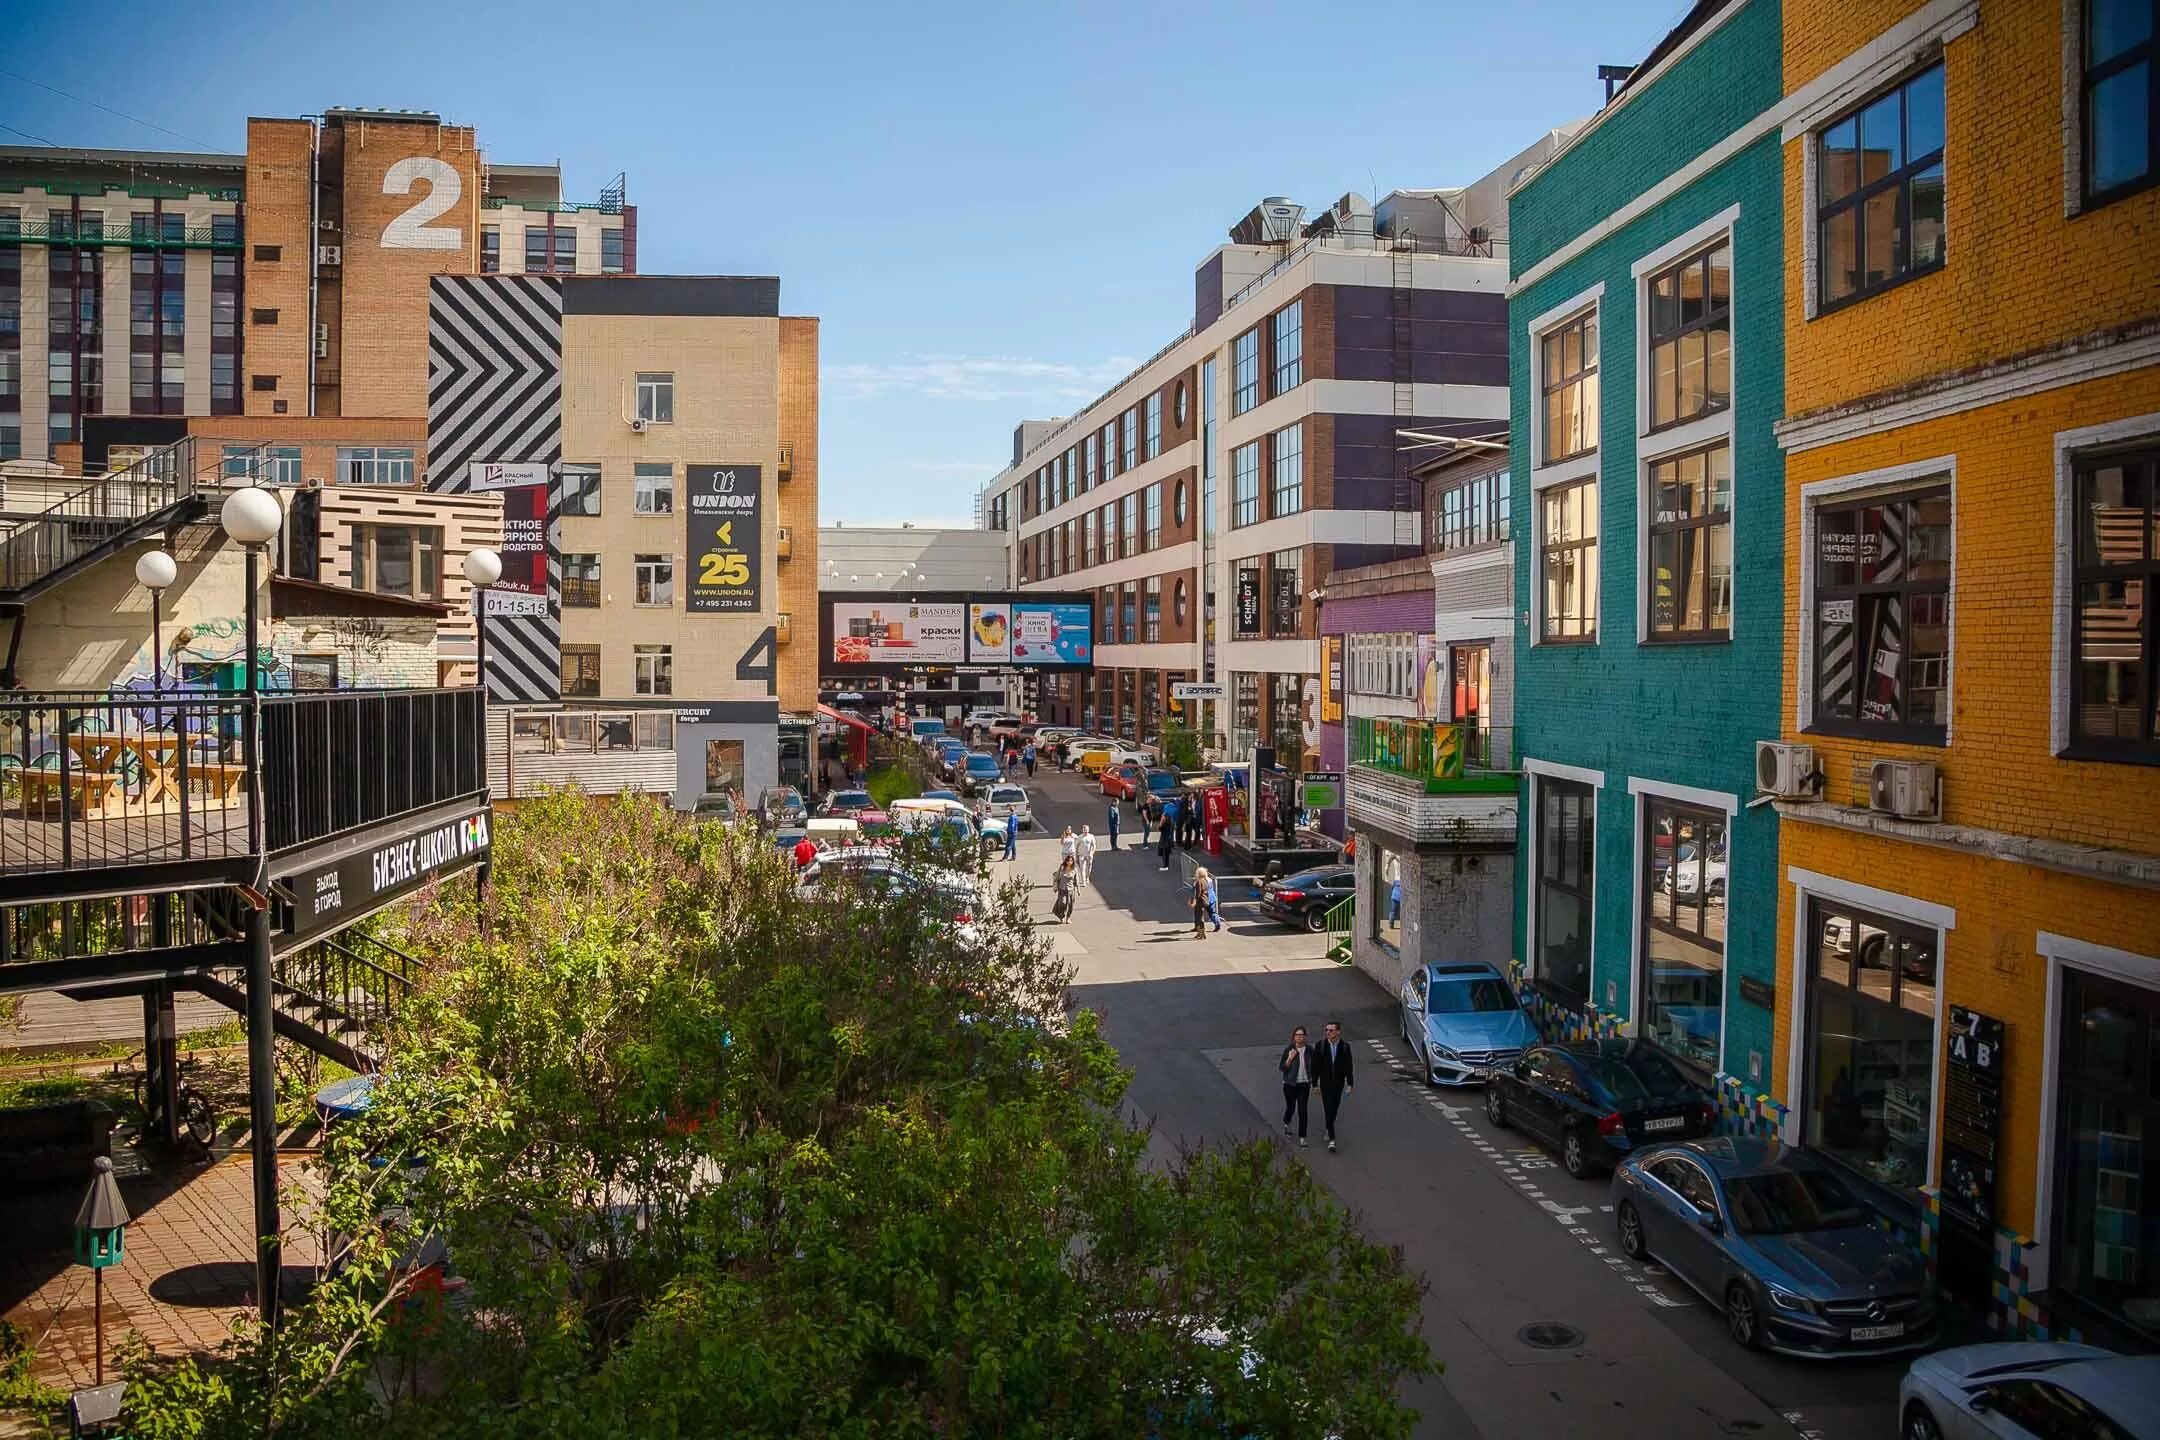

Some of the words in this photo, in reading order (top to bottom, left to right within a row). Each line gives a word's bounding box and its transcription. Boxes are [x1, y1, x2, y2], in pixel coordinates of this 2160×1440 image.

[381, 156, 462, 249] 2
[692, 494, 756, 508] UNION
[504, 520, 543, 529] КТНОЕ
[504, 532, 543, 541] ЯРНОЕ
[503, 543, 544, 551] ВОДСТВО
[699, 553, 750, 586] 25
[491, 580, 530, 591] edbuk.ru
[920, 627, 961, 636] краски
[735, 625, 777, 697] 4
[373, 825, 458, 892] БИЗНЕС-ШКОЛА
[320, 889, 342, 912] ГОРОД
[1967, 1011, 1980, 1037] 7
